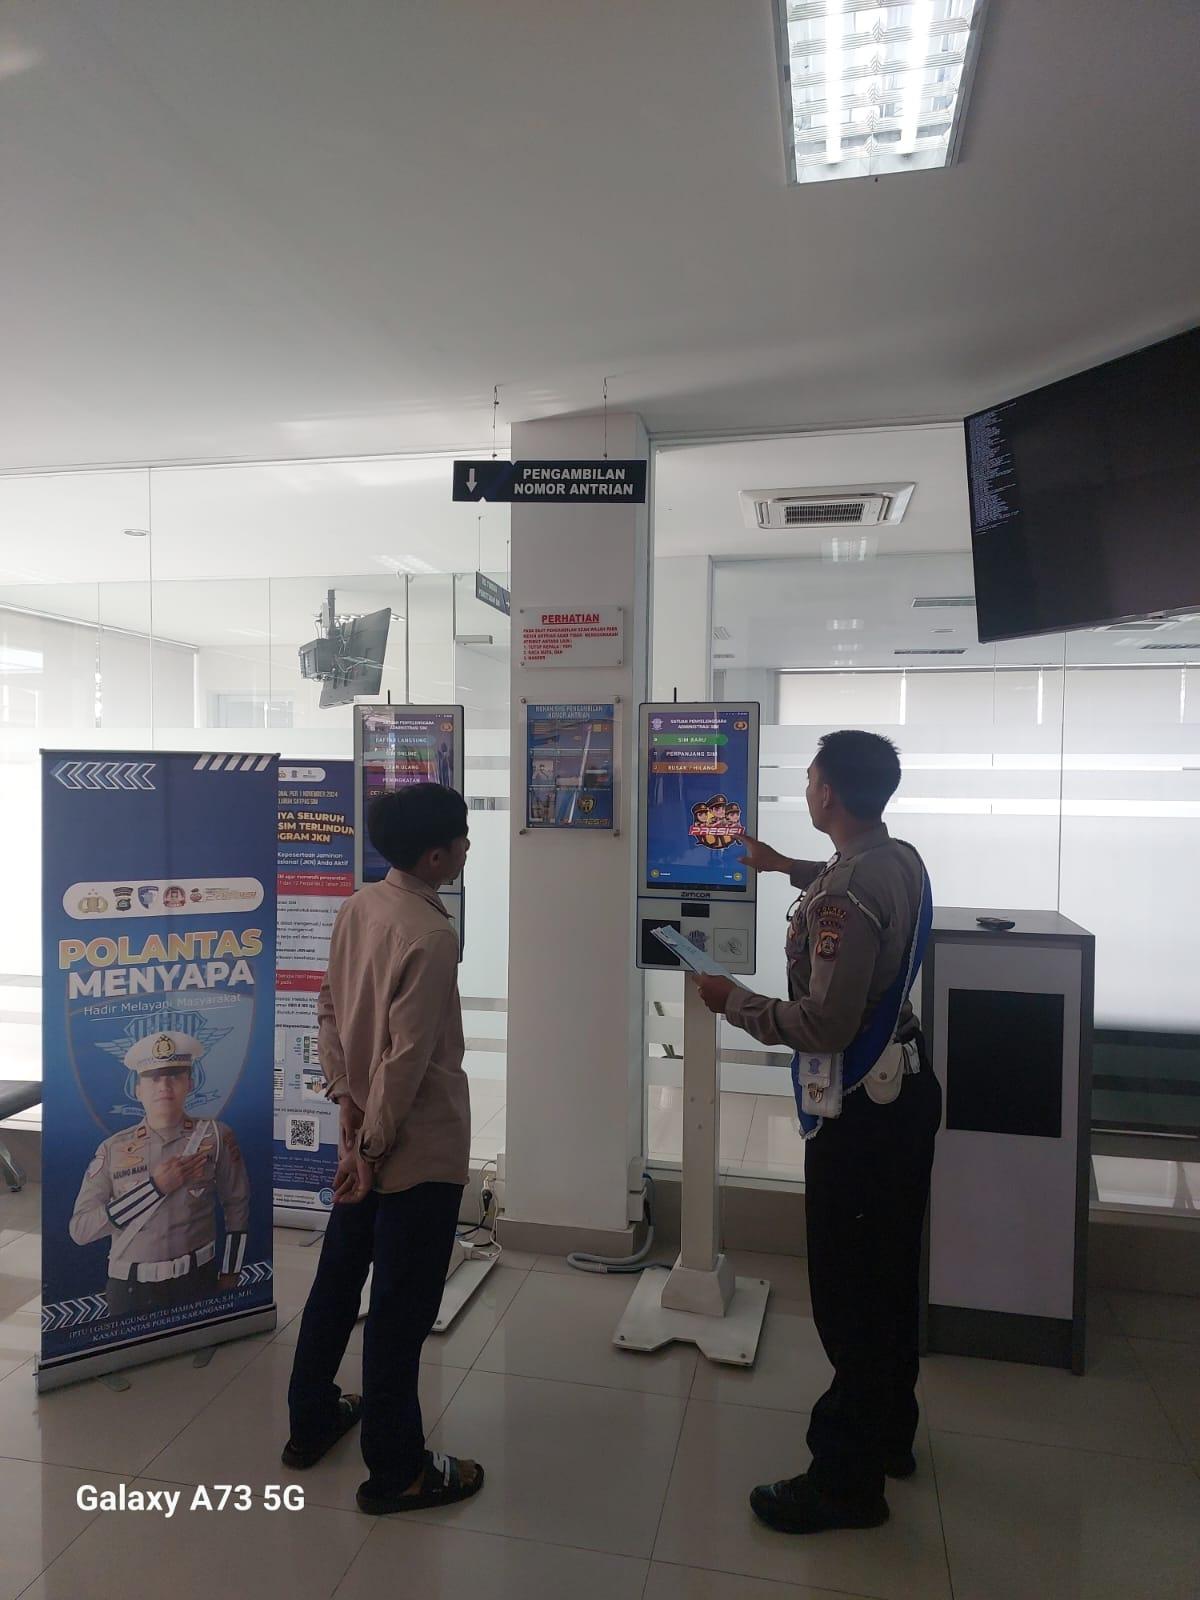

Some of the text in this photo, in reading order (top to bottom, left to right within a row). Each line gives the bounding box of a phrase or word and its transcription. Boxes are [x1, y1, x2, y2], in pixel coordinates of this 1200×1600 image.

[523, 468, 626, 480] PENGAMBILAN
[514, 483, 634, 495] NOMOR ANTRIAN
[541, 614, 600, 623] PERHATIAN
[297, 812, 345, 823] SELURUH
[277, 822, 296, 830] SIM
[690, 827, 742, 836] PRESISI
[277, 832, 331, 843] GRAM JKN
[58, 928, 263, 970] POLANTAS
[68, 959, 256, 1000] MENYAPA
[84, 1004, 116, 1017] Hadir
[176, 993, 241, 1008] Masyarakat
[92, 1303, 234, 1342] KASAT LANTAS POLRES KARANGASEM
[94, 1322, 119, 1335] GUSTI
[119, 1314, 149, 1329] AGUNG
[170, 1304, 194, 1315] MAHA
